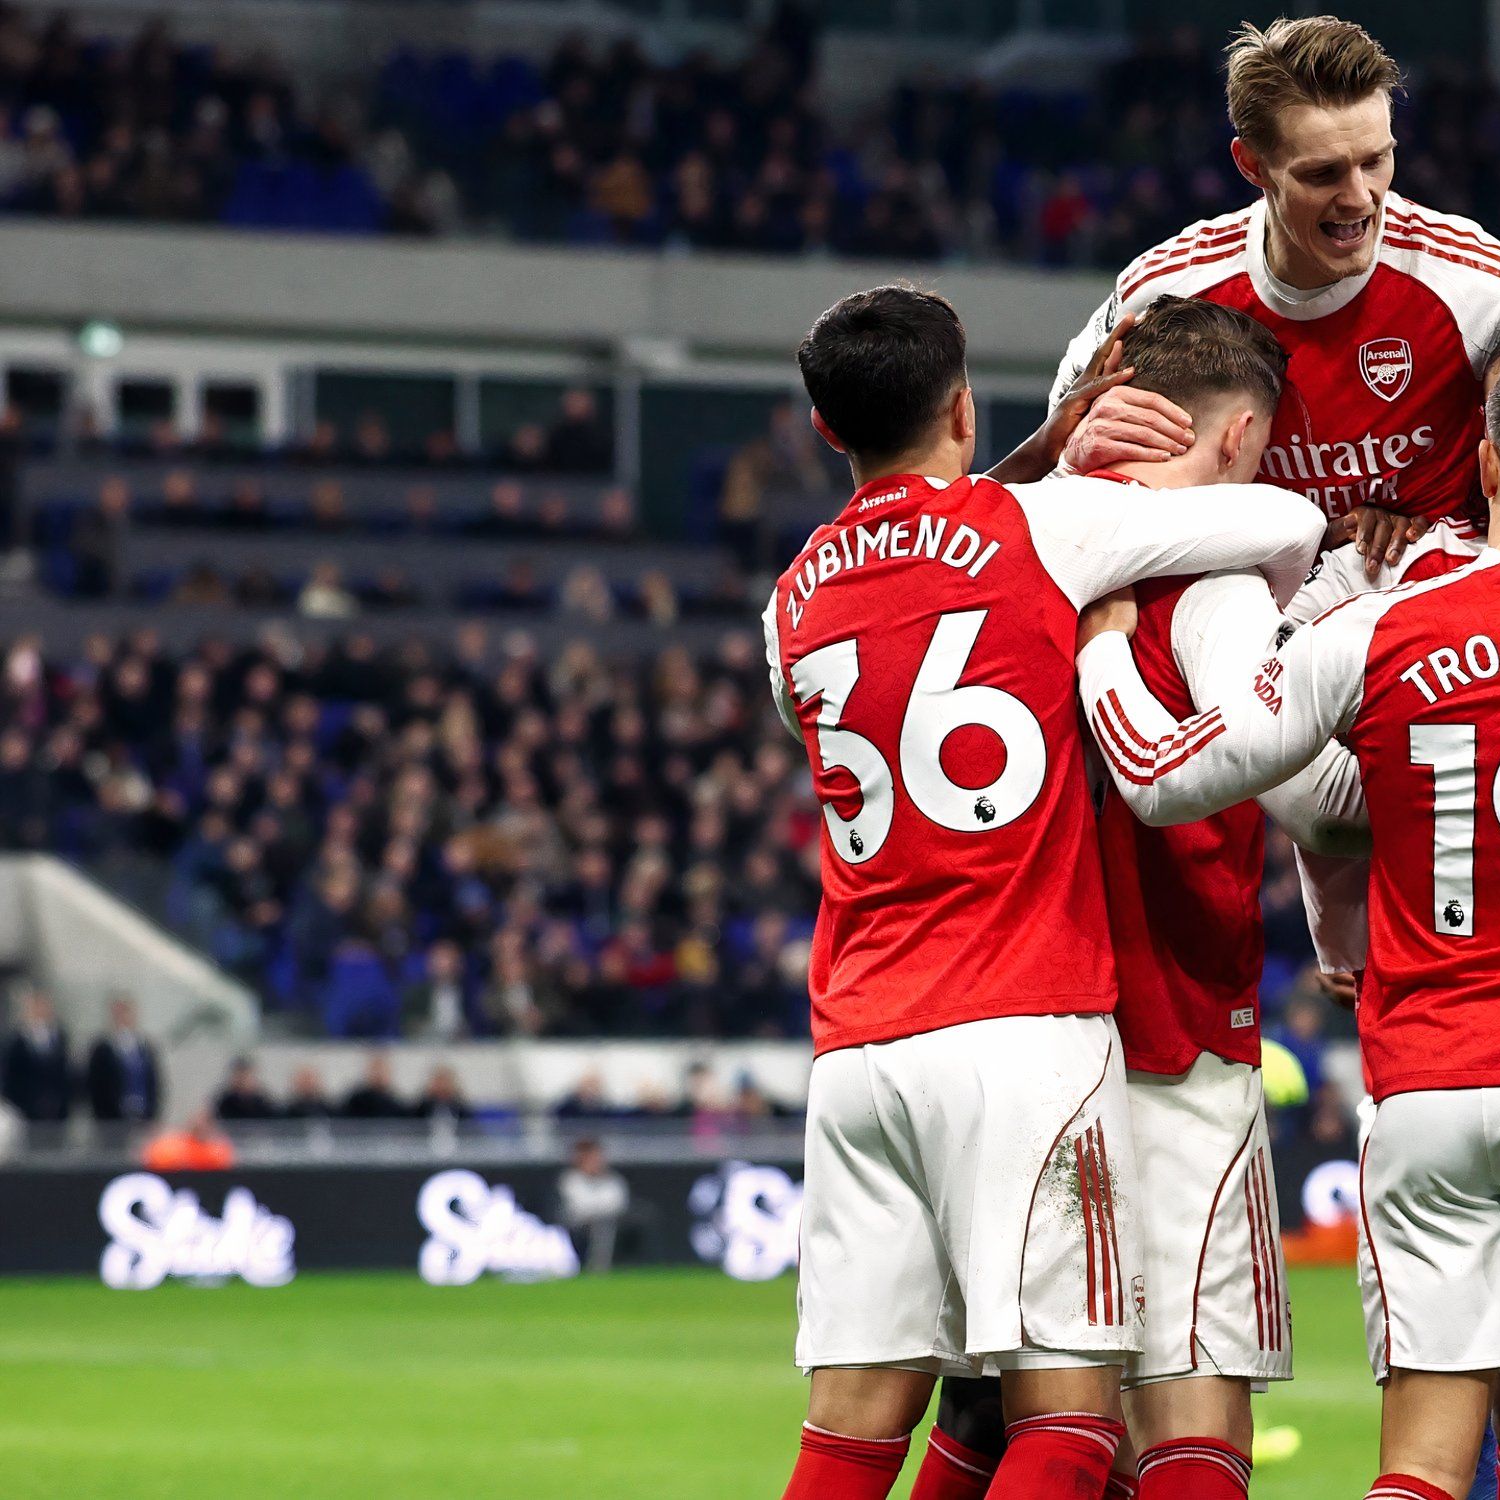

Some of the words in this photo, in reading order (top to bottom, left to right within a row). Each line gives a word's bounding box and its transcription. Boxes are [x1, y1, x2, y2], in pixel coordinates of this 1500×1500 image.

[1366, 348, 1405, 361] Arsenal
[1258, 425, 1435, 480] mirates
[858, 486, 908, 513] Arsenal
[785, 513, 1002, 631] ZUBIMENDI
[1262, 657, 1284, 682] SIT
[789, 608, 1047, 865] 36
